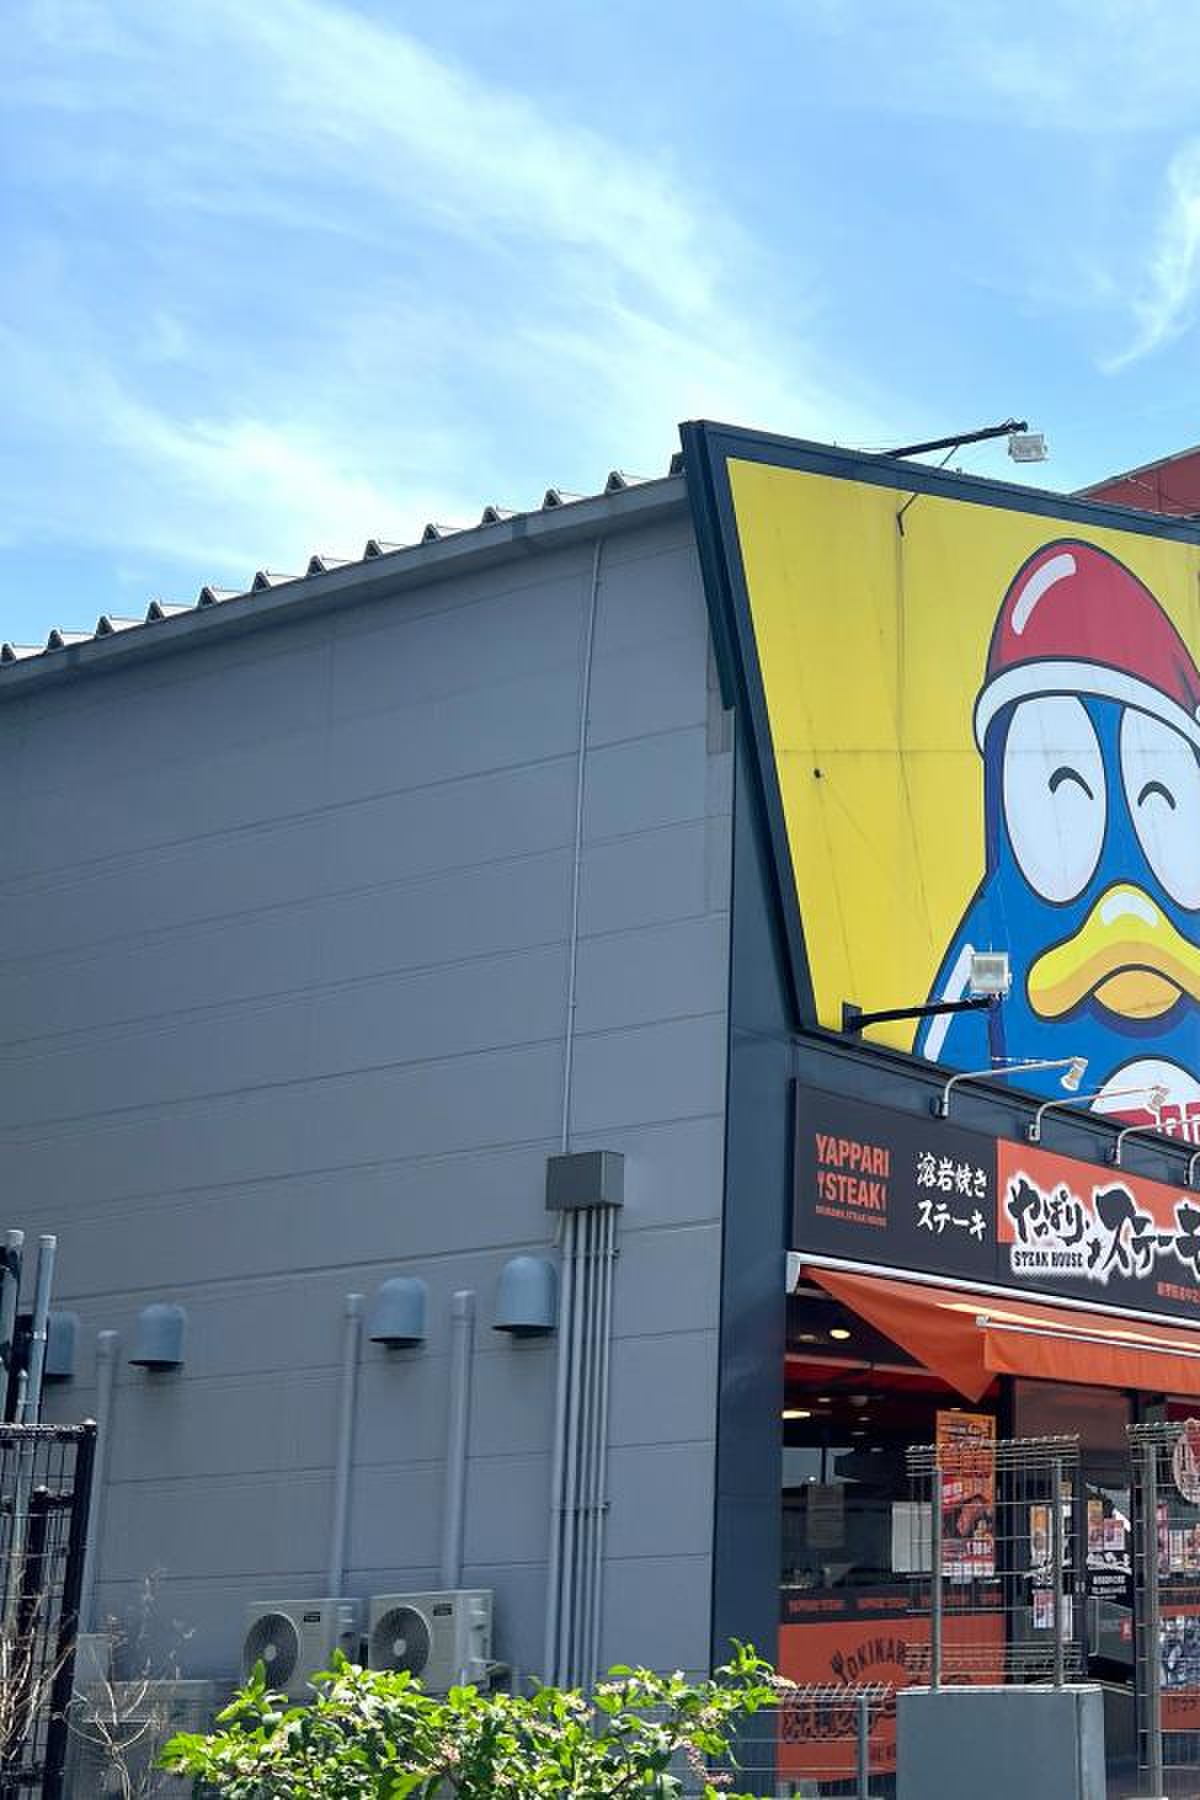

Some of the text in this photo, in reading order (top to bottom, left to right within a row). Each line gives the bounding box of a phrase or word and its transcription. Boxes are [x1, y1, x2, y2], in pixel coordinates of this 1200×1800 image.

[816, 1134, 890, 1178] YAPPARI
[916, 1151, 987, 1199] 溶岩焼き
[916, 1199, 987, 1242] ステーキ
